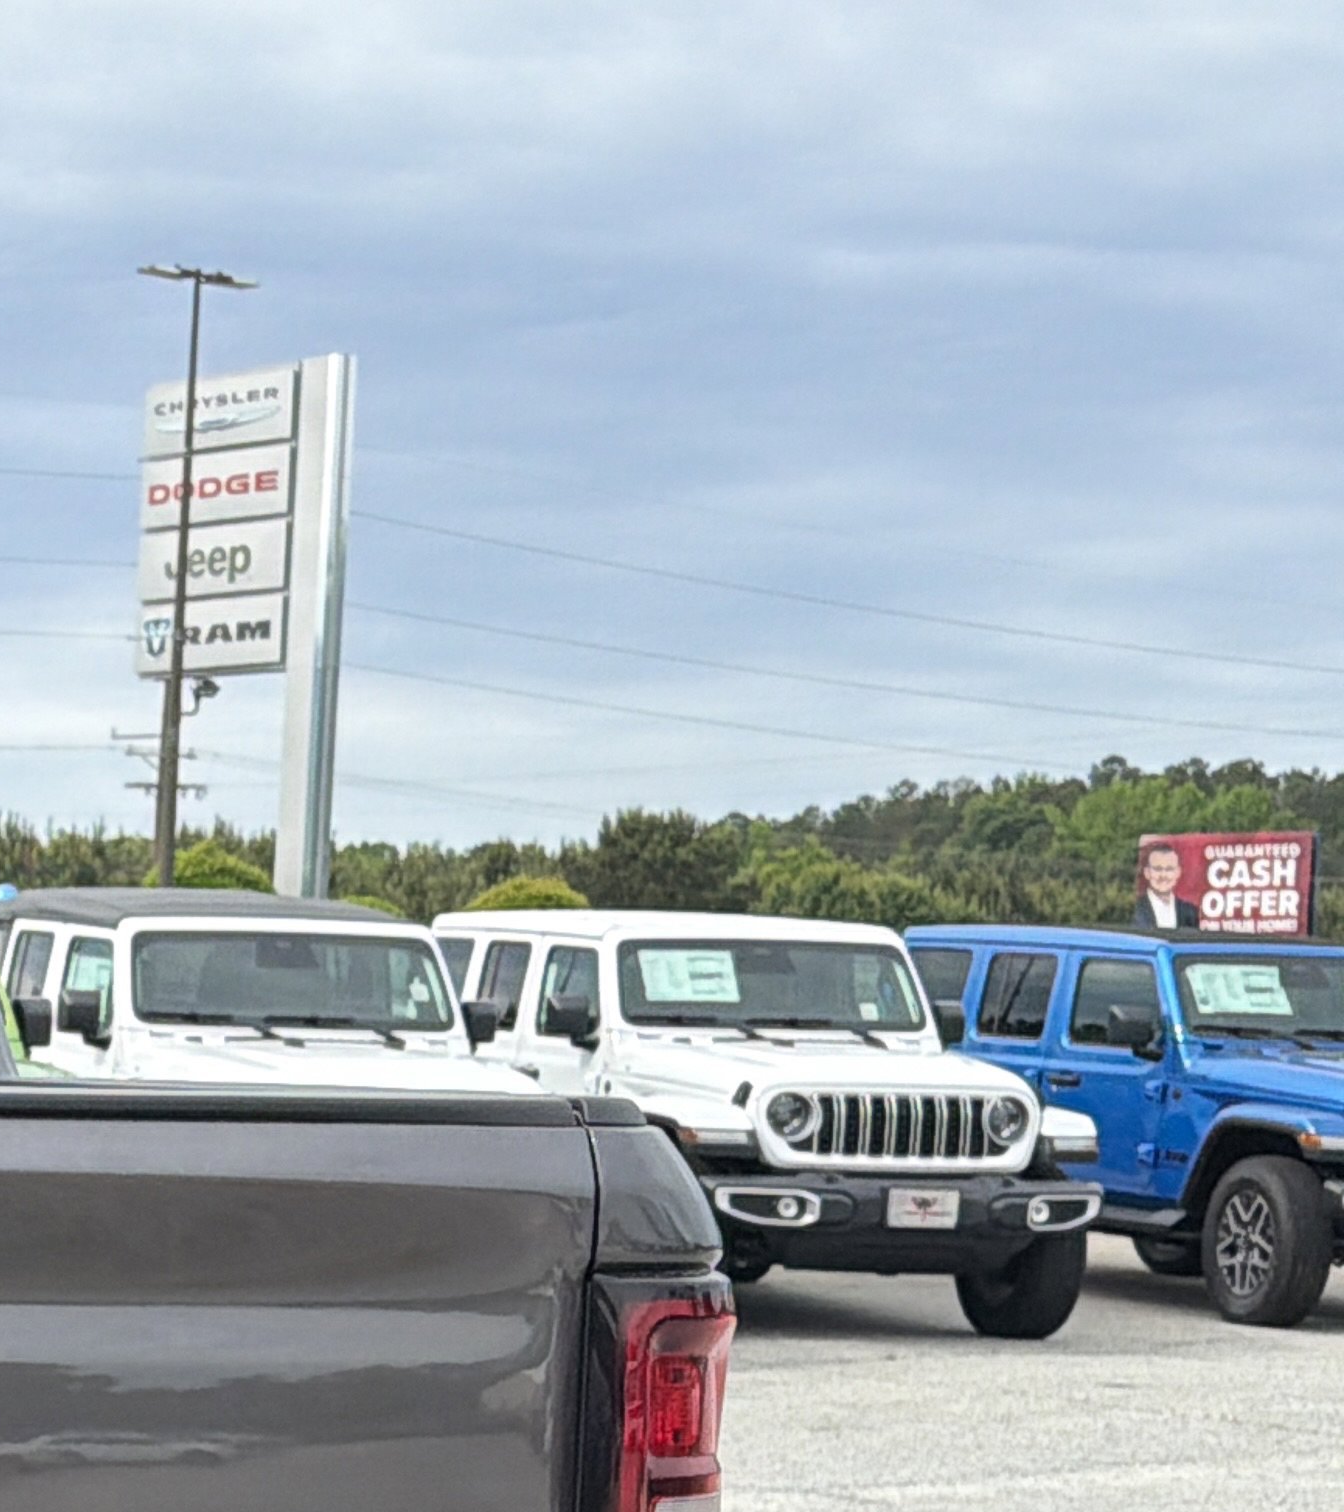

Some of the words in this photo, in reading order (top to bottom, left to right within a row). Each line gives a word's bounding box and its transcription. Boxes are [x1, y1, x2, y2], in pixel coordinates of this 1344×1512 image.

[154, 387, 279, 416] CHYSLER
[1207, 859, 1297, 888] CASH
[1201, 889, 1300, 918] OFFER
